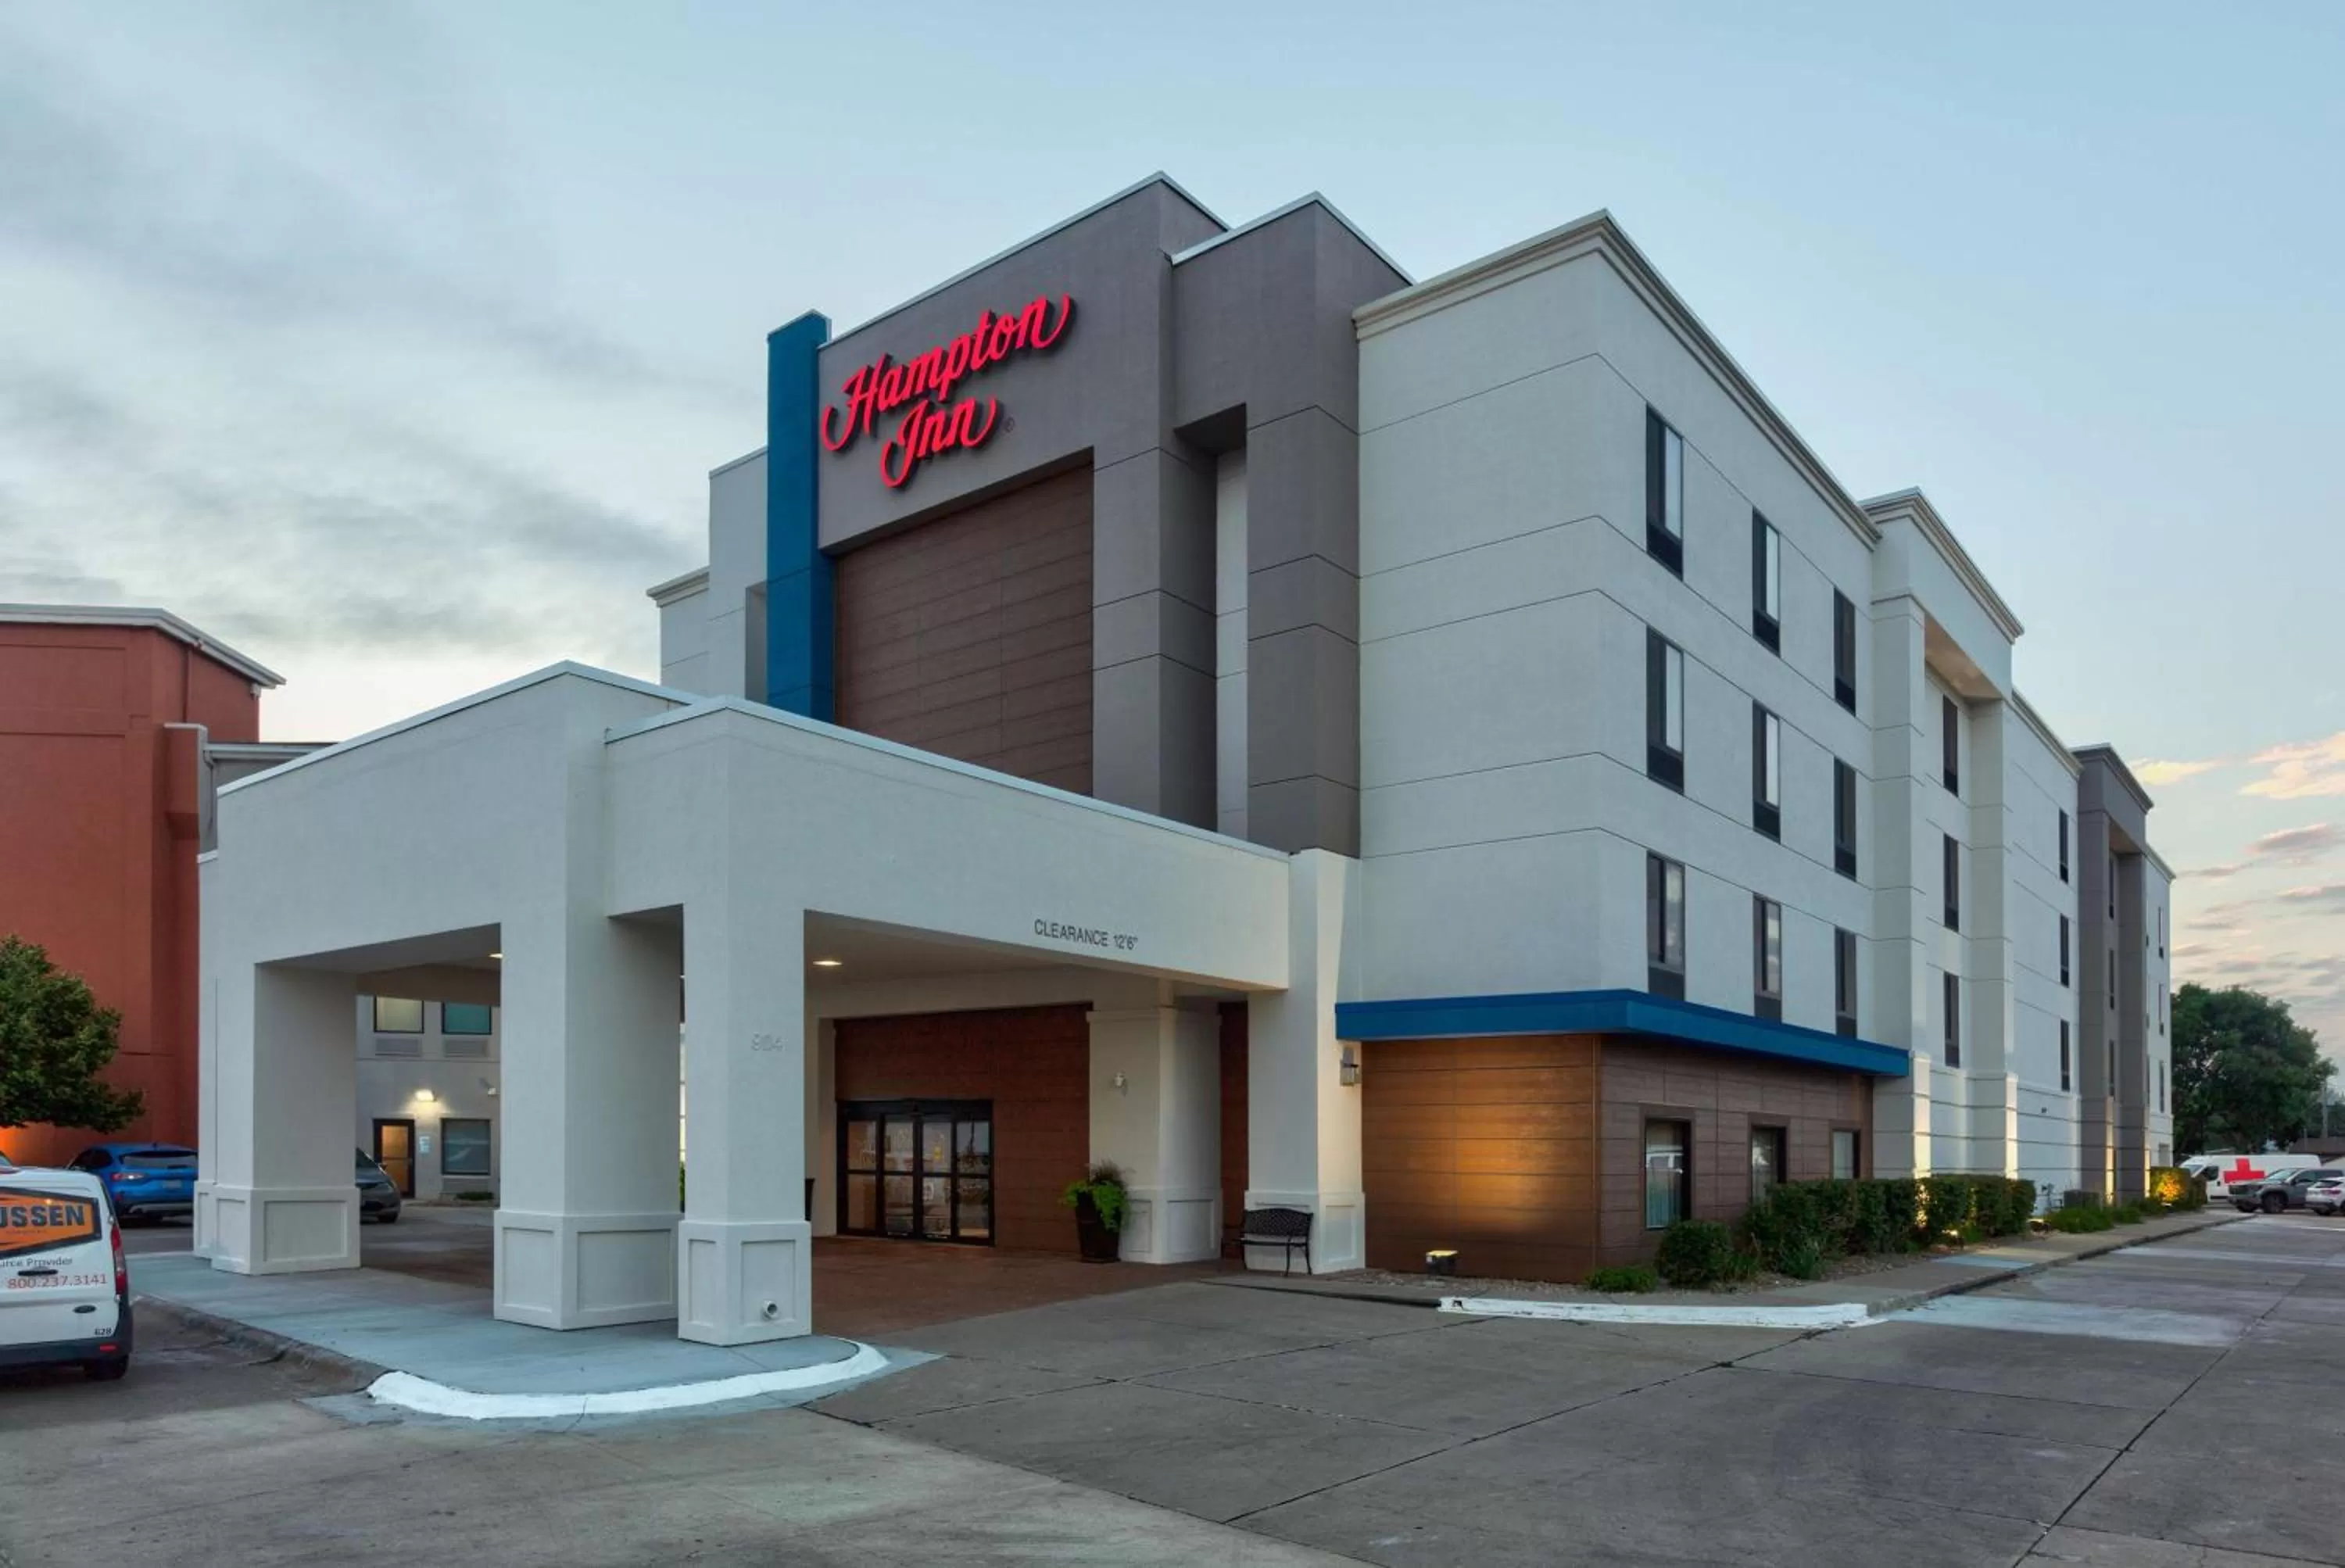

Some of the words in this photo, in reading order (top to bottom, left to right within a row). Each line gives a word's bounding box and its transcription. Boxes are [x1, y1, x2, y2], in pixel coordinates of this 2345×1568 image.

[822, 293, 1072, 451] Hampton
[880, 395, 997, 489] Inn
[1034, 918, 1109, 947] CLEARANCE
[26, 1255, 73, 1266] Provider
